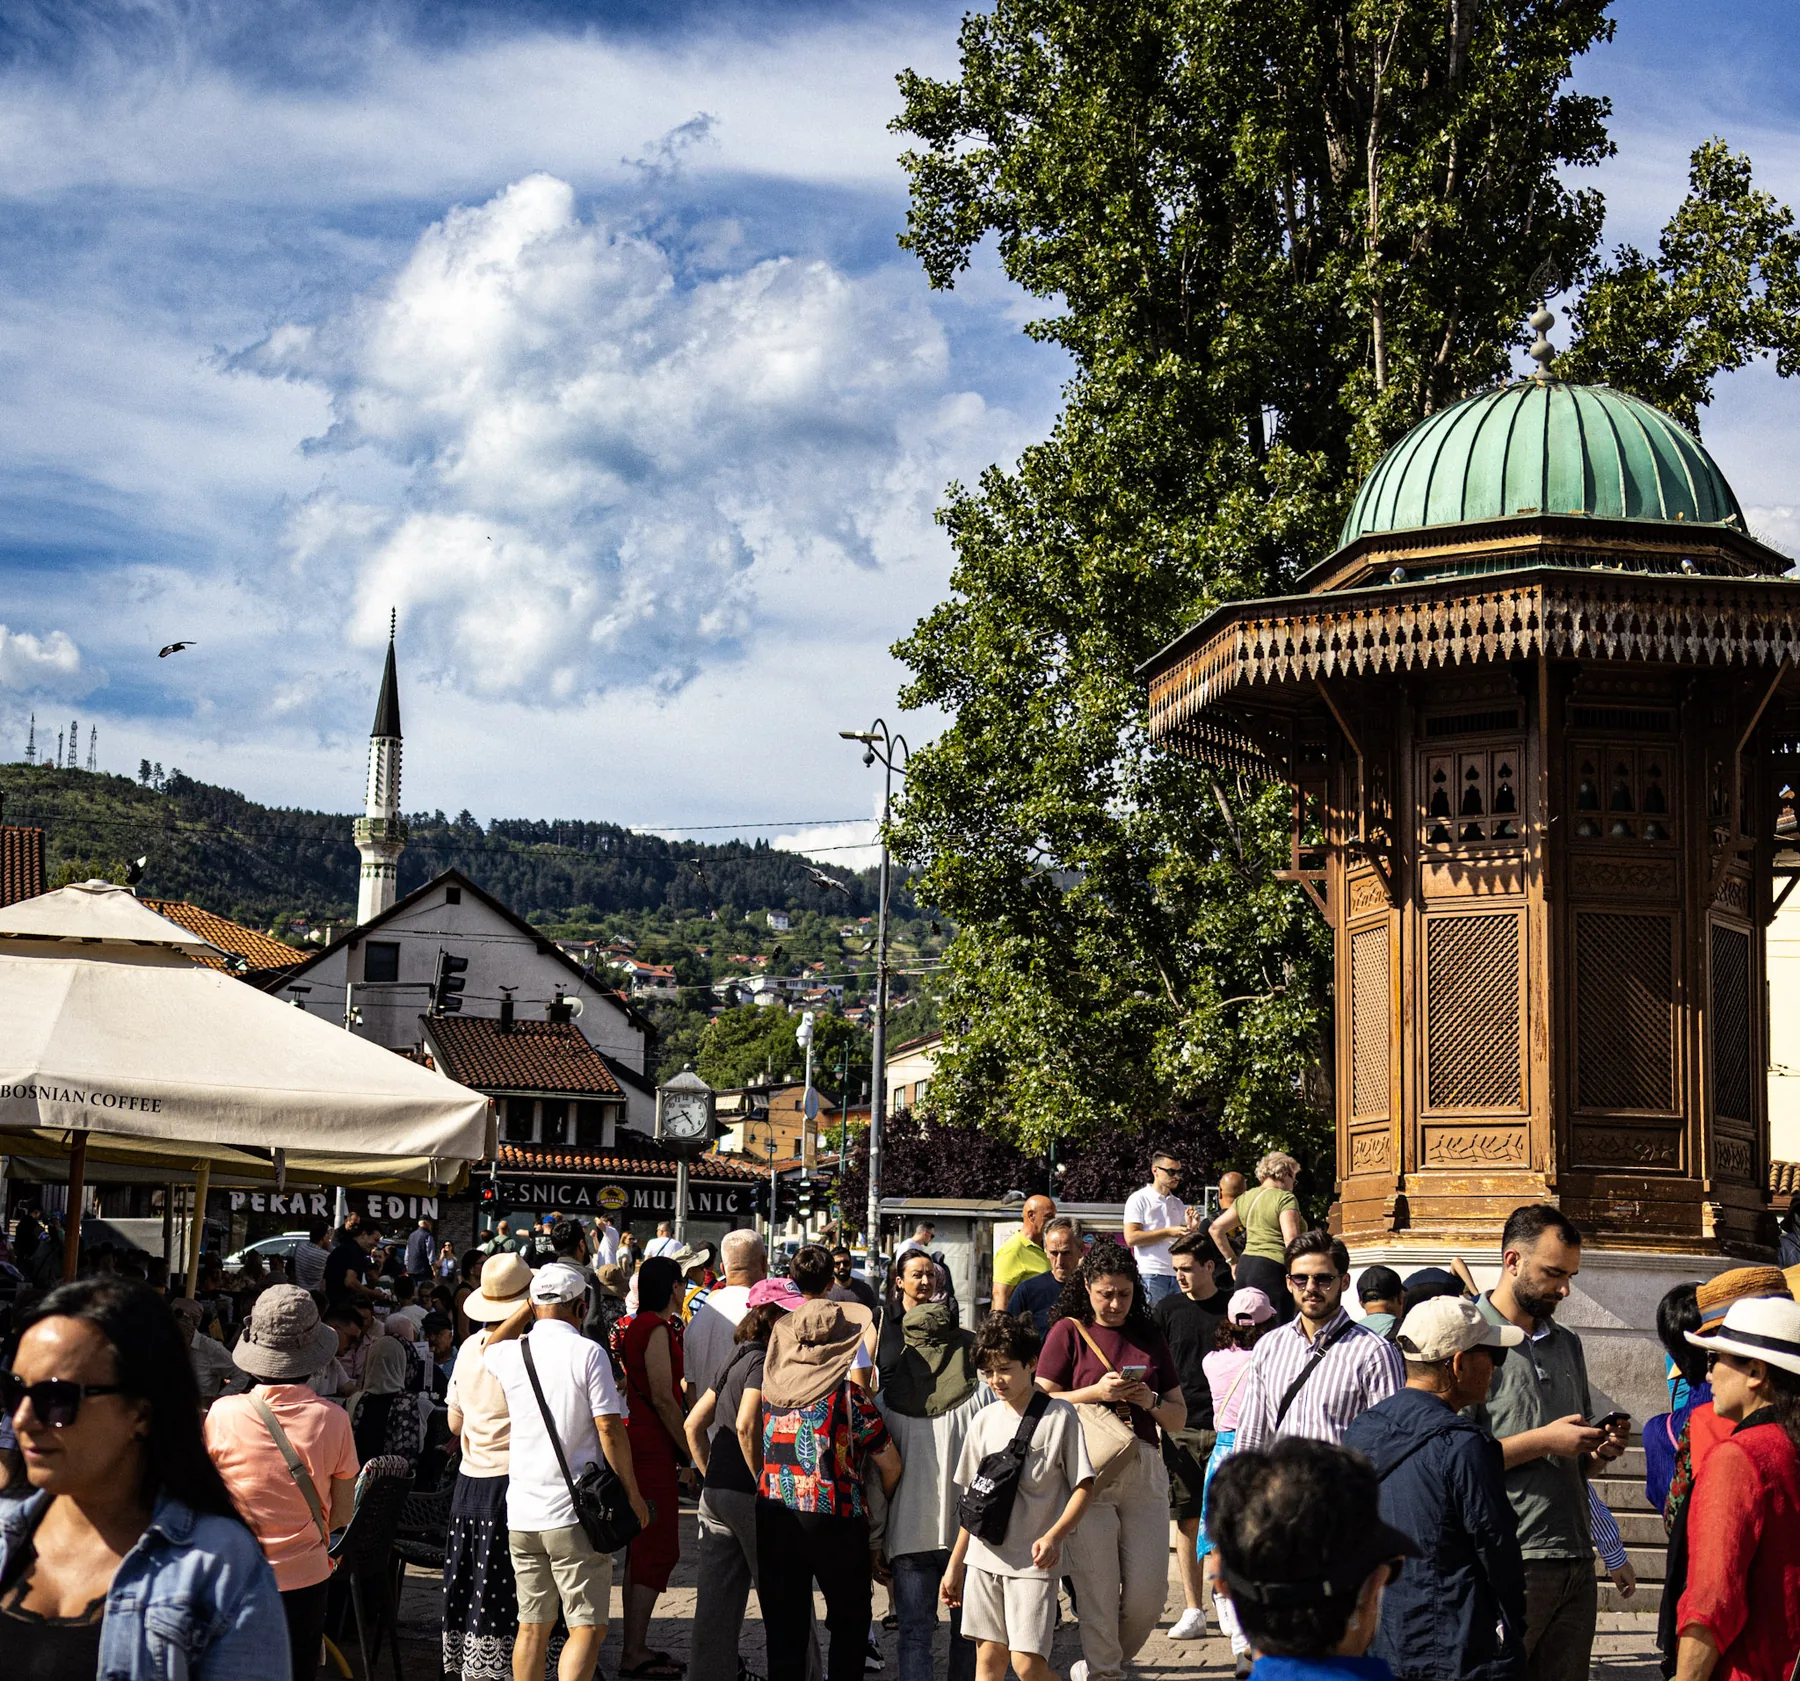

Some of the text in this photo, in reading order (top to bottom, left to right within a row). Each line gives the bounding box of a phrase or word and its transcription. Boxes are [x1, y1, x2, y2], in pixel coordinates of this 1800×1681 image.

[1, 1084, 162, 1113] BOSNIAN COFFEE
[367, 1194, 438, 1220] EDIN
